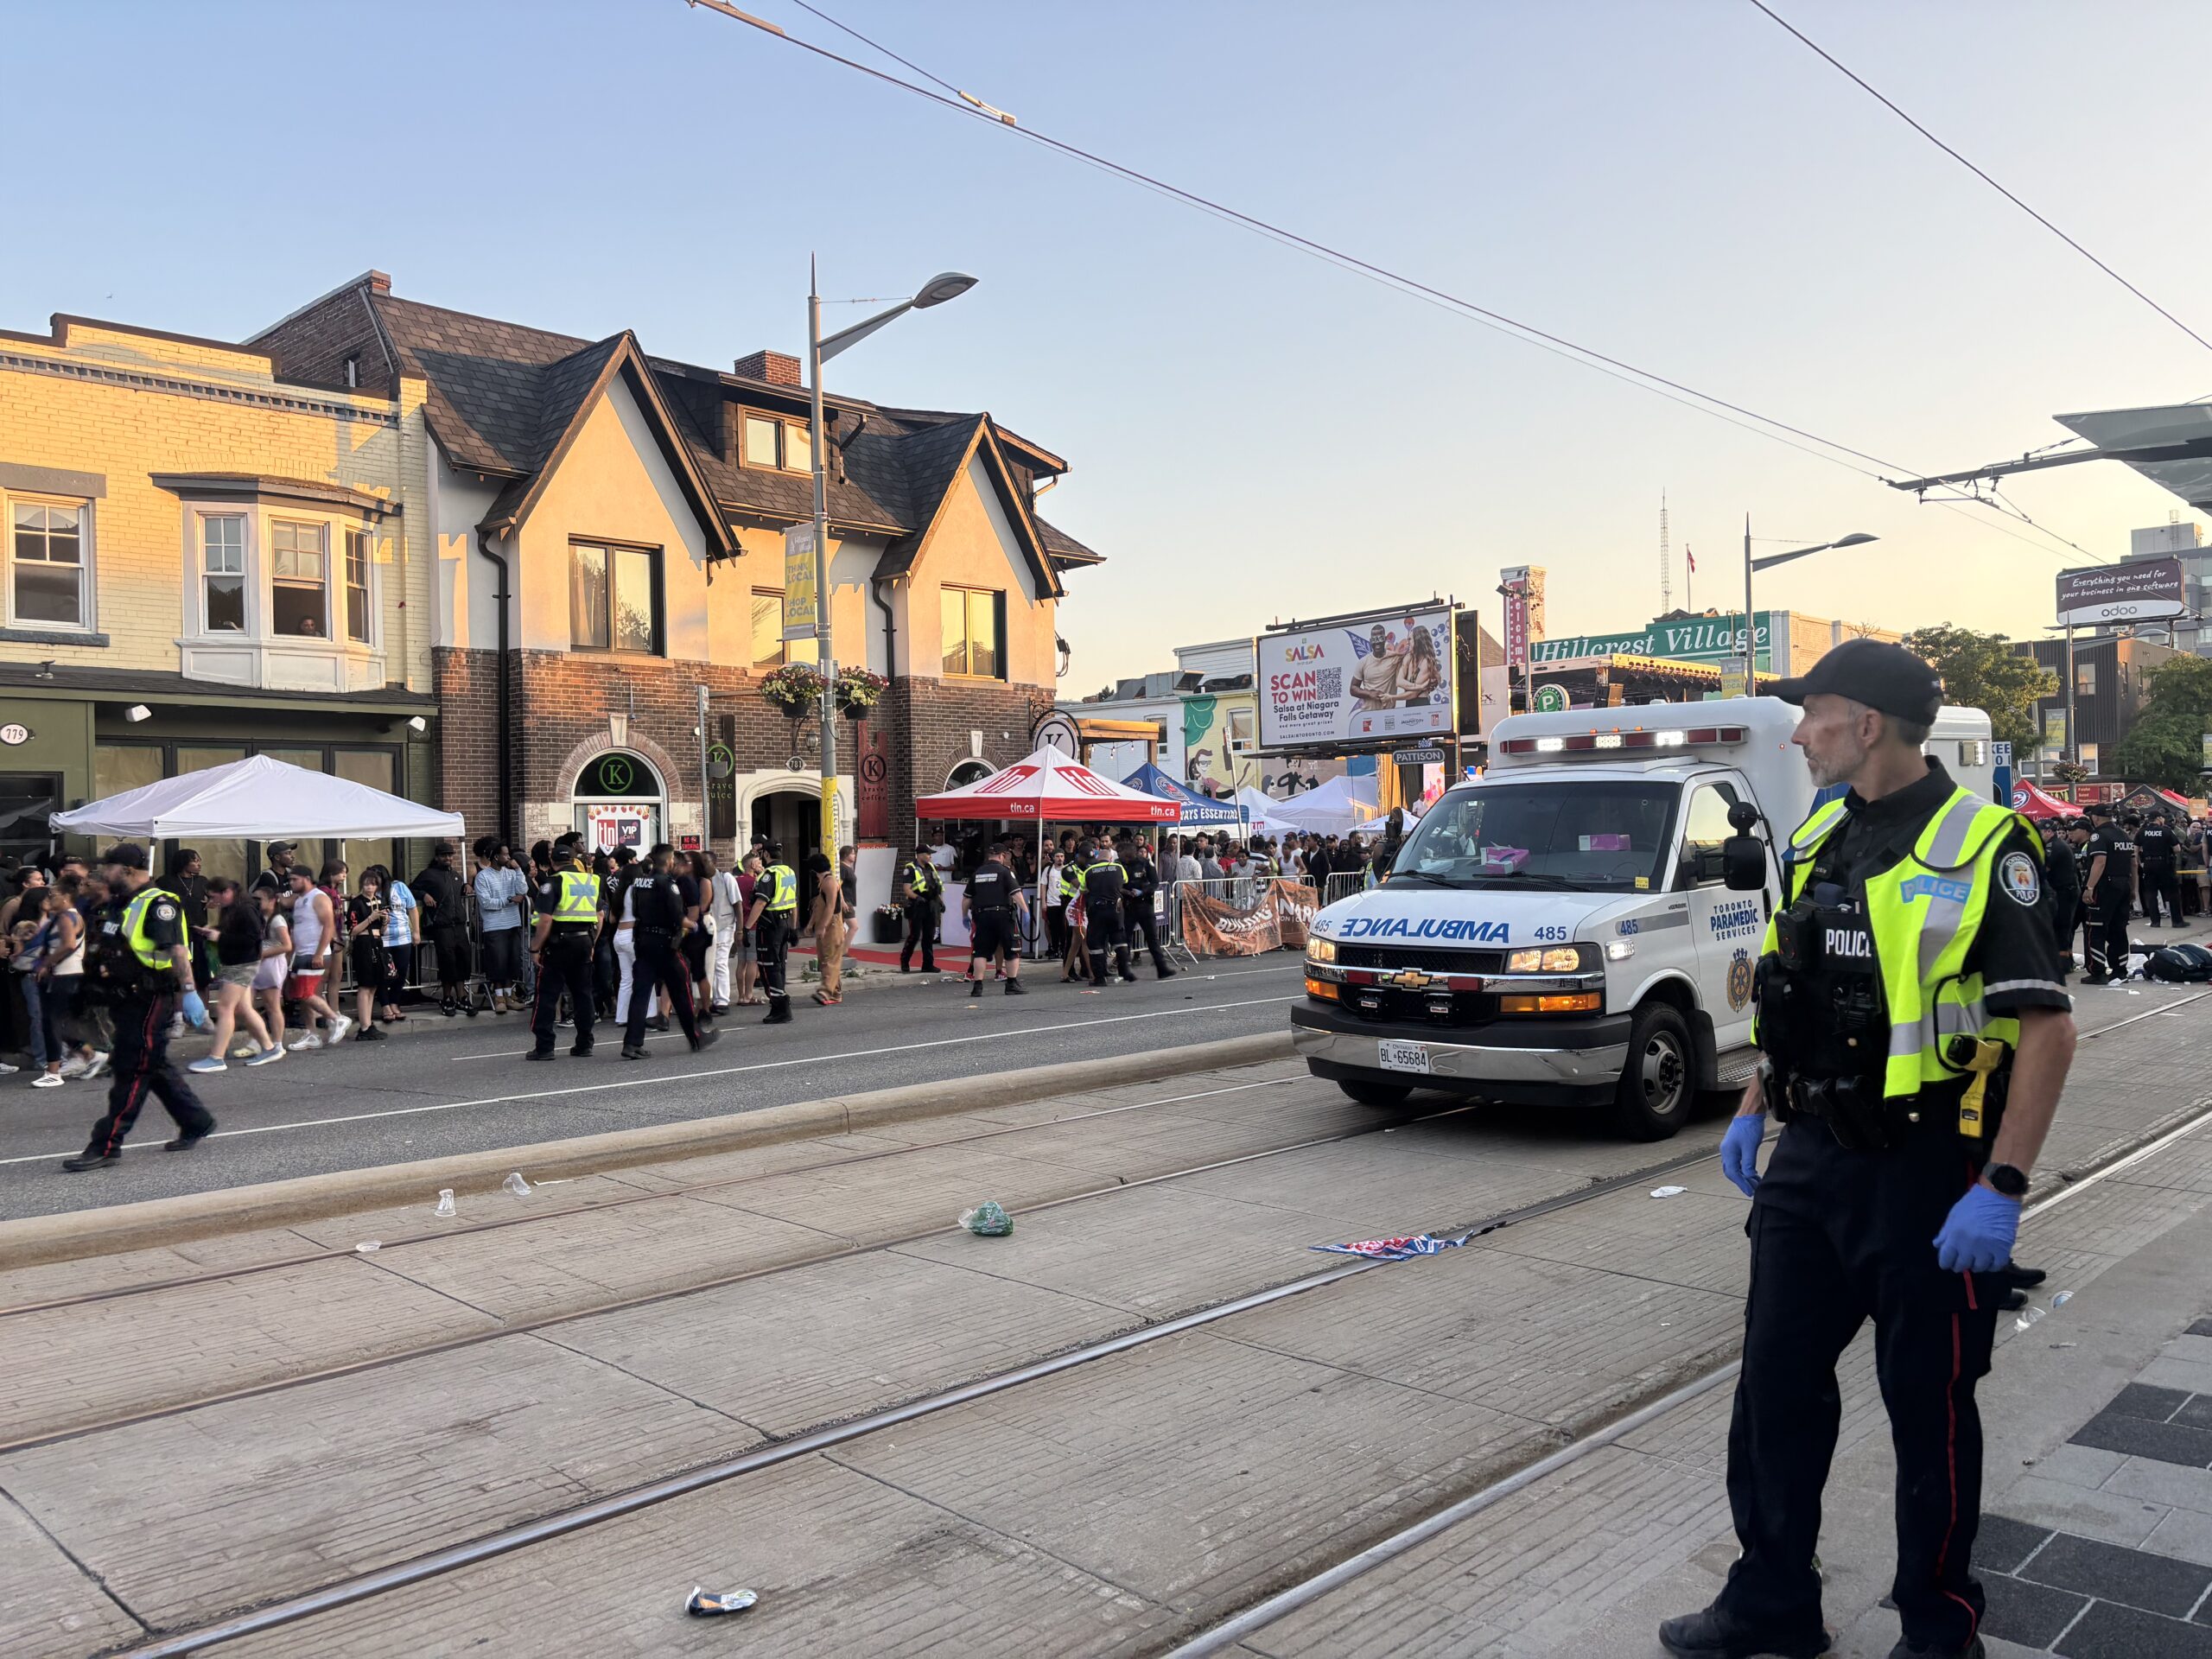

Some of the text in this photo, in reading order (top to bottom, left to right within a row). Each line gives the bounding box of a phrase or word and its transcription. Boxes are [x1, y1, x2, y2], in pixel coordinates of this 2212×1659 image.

[787, 563, 808, 575] THINK
[787, 571, 814, 584] LOCAL
[2072, 569, 2166, 587] Everything you need for
[2061, 592, 2079, 601] your
[2081, 588, 2113, 596] business
[2143, 581, 2178, 591] software
[785, 596, 806, 608] SHOP
[785, 606, 815, 618] LOCAL
[2101, 606, 2138, 617] odoo
[1515, 593, 1523, 664] elcome
[1541, 624, 1768, 661] Hillcrest Village
[1286, 644, 1325, 663] SALSA
[1270, 671, 1316, 690] SCAN
[1272, 688, 1317, 704] TO WIN
[1542, 696, 1554, 710] P
[1274, 701, 1339, 714] Salsa at Niagara
[1279, 710, 1334, 722] Falls Getaway
[6, 728, 23, 740] 779
[1396, 752, 1441, 761] PATTISON
[607, 765, 625, 785] K
[868, 760, 880, 776] K
[1010, 803, 1035, 813] tln.ca
[1150, 805, 1175, 817] tln.ca
[1200, 809, 1238, 820] ESSENTIAL
[599, 823, 615, 846] tln
[622, 826, 637, 835] VIP
[2114, 842, 2134, 850] POLICE
[634, 877, 655, 889] POLICE
[1904, 877, 1967, 900] PLICE
[1713, 899, 1753, 914] TORONTO
[1314, 919, 1332, 933] 485
[1620, 918, 1638, 935] 485
[1710, 908, 1758, 931] PARAMEDIC
[1534, 925, 1567, 941] 485
[1716, 925, 1756, 941] SERVICES
[1380, 1048, 1426, 1066] BL 65684
